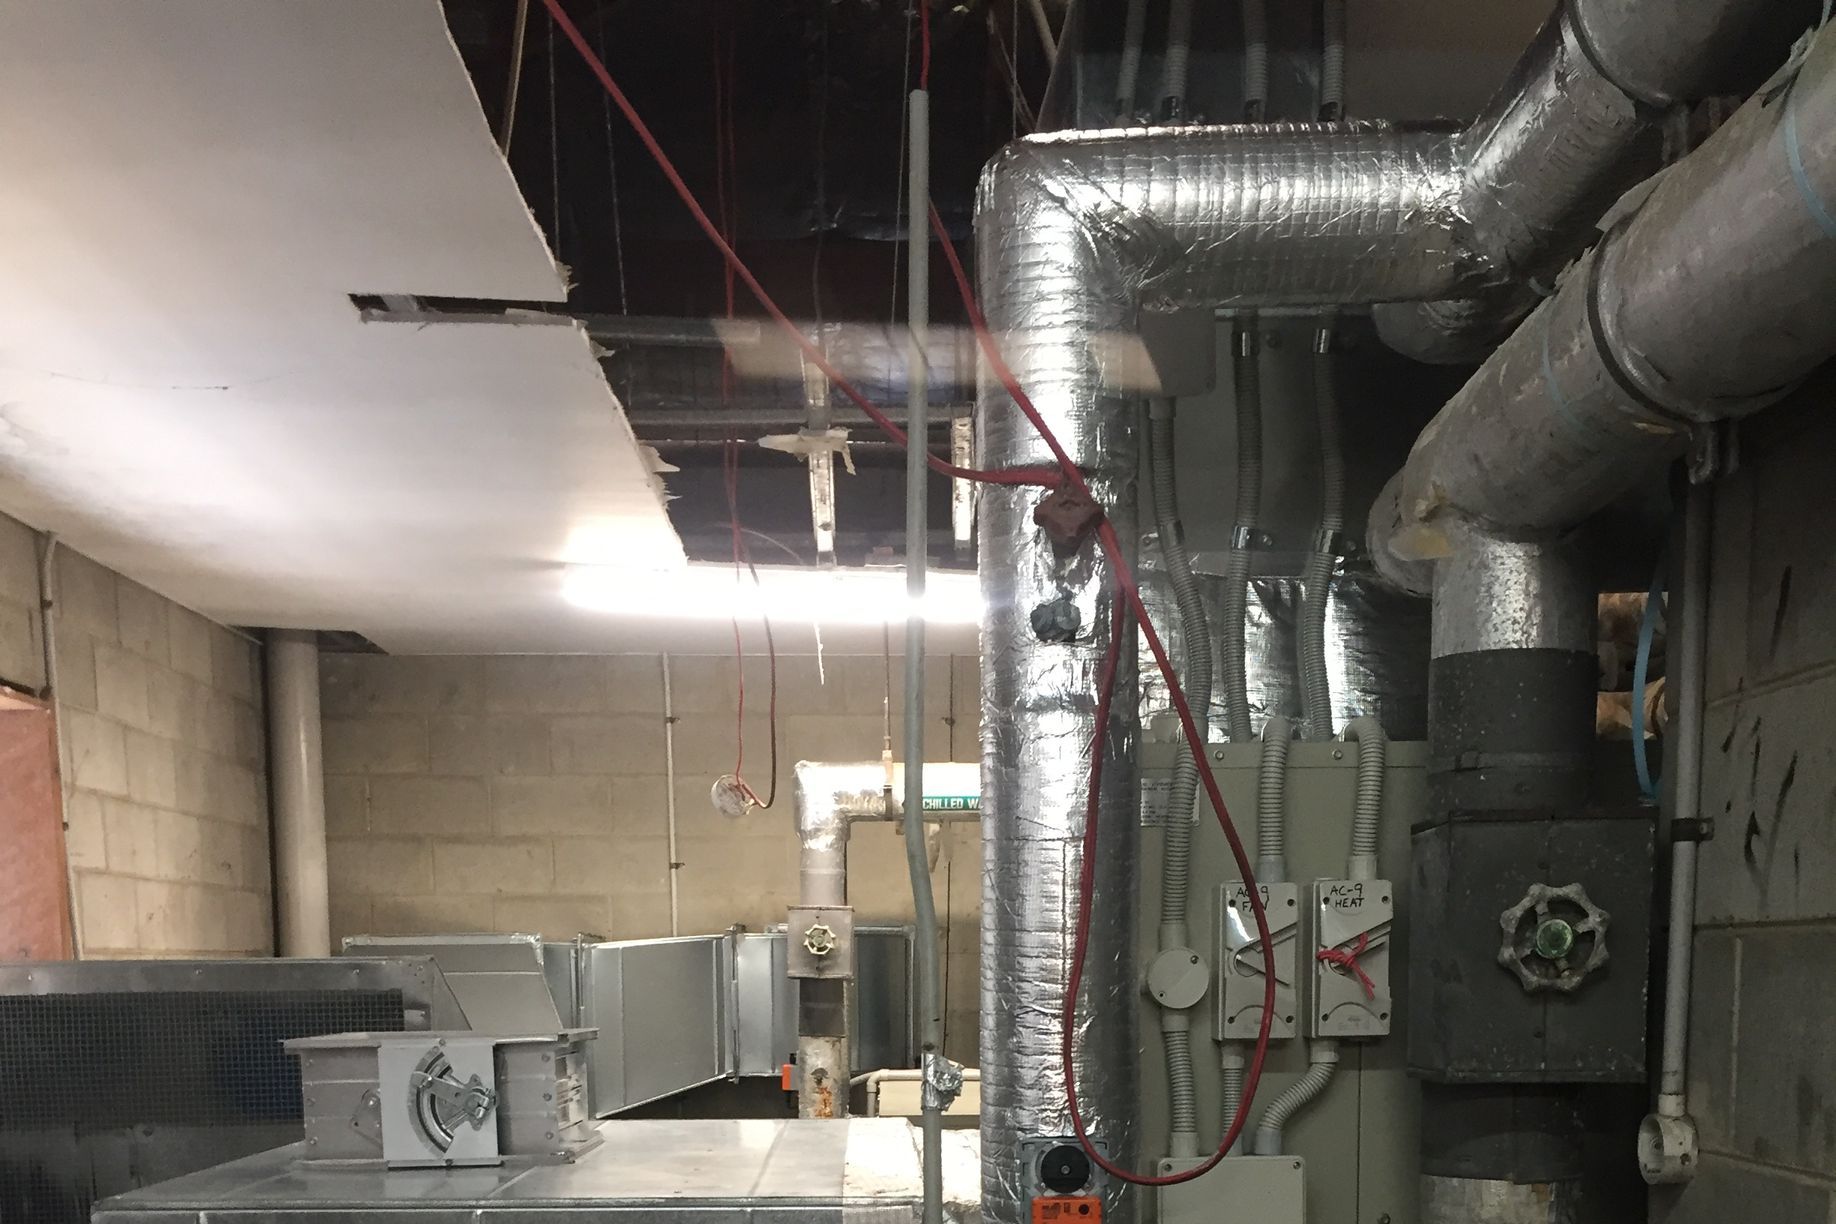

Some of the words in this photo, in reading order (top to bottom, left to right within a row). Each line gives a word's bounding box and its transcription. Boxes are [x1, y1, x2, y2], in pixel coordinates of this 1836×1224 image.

[922, 798, 964, 809] CHILLED
[1236, 885, 1270, 900] AC9
[1330, 883, 1363, 898] AC-9
[1335, 897, 1365, 908] HEAT
